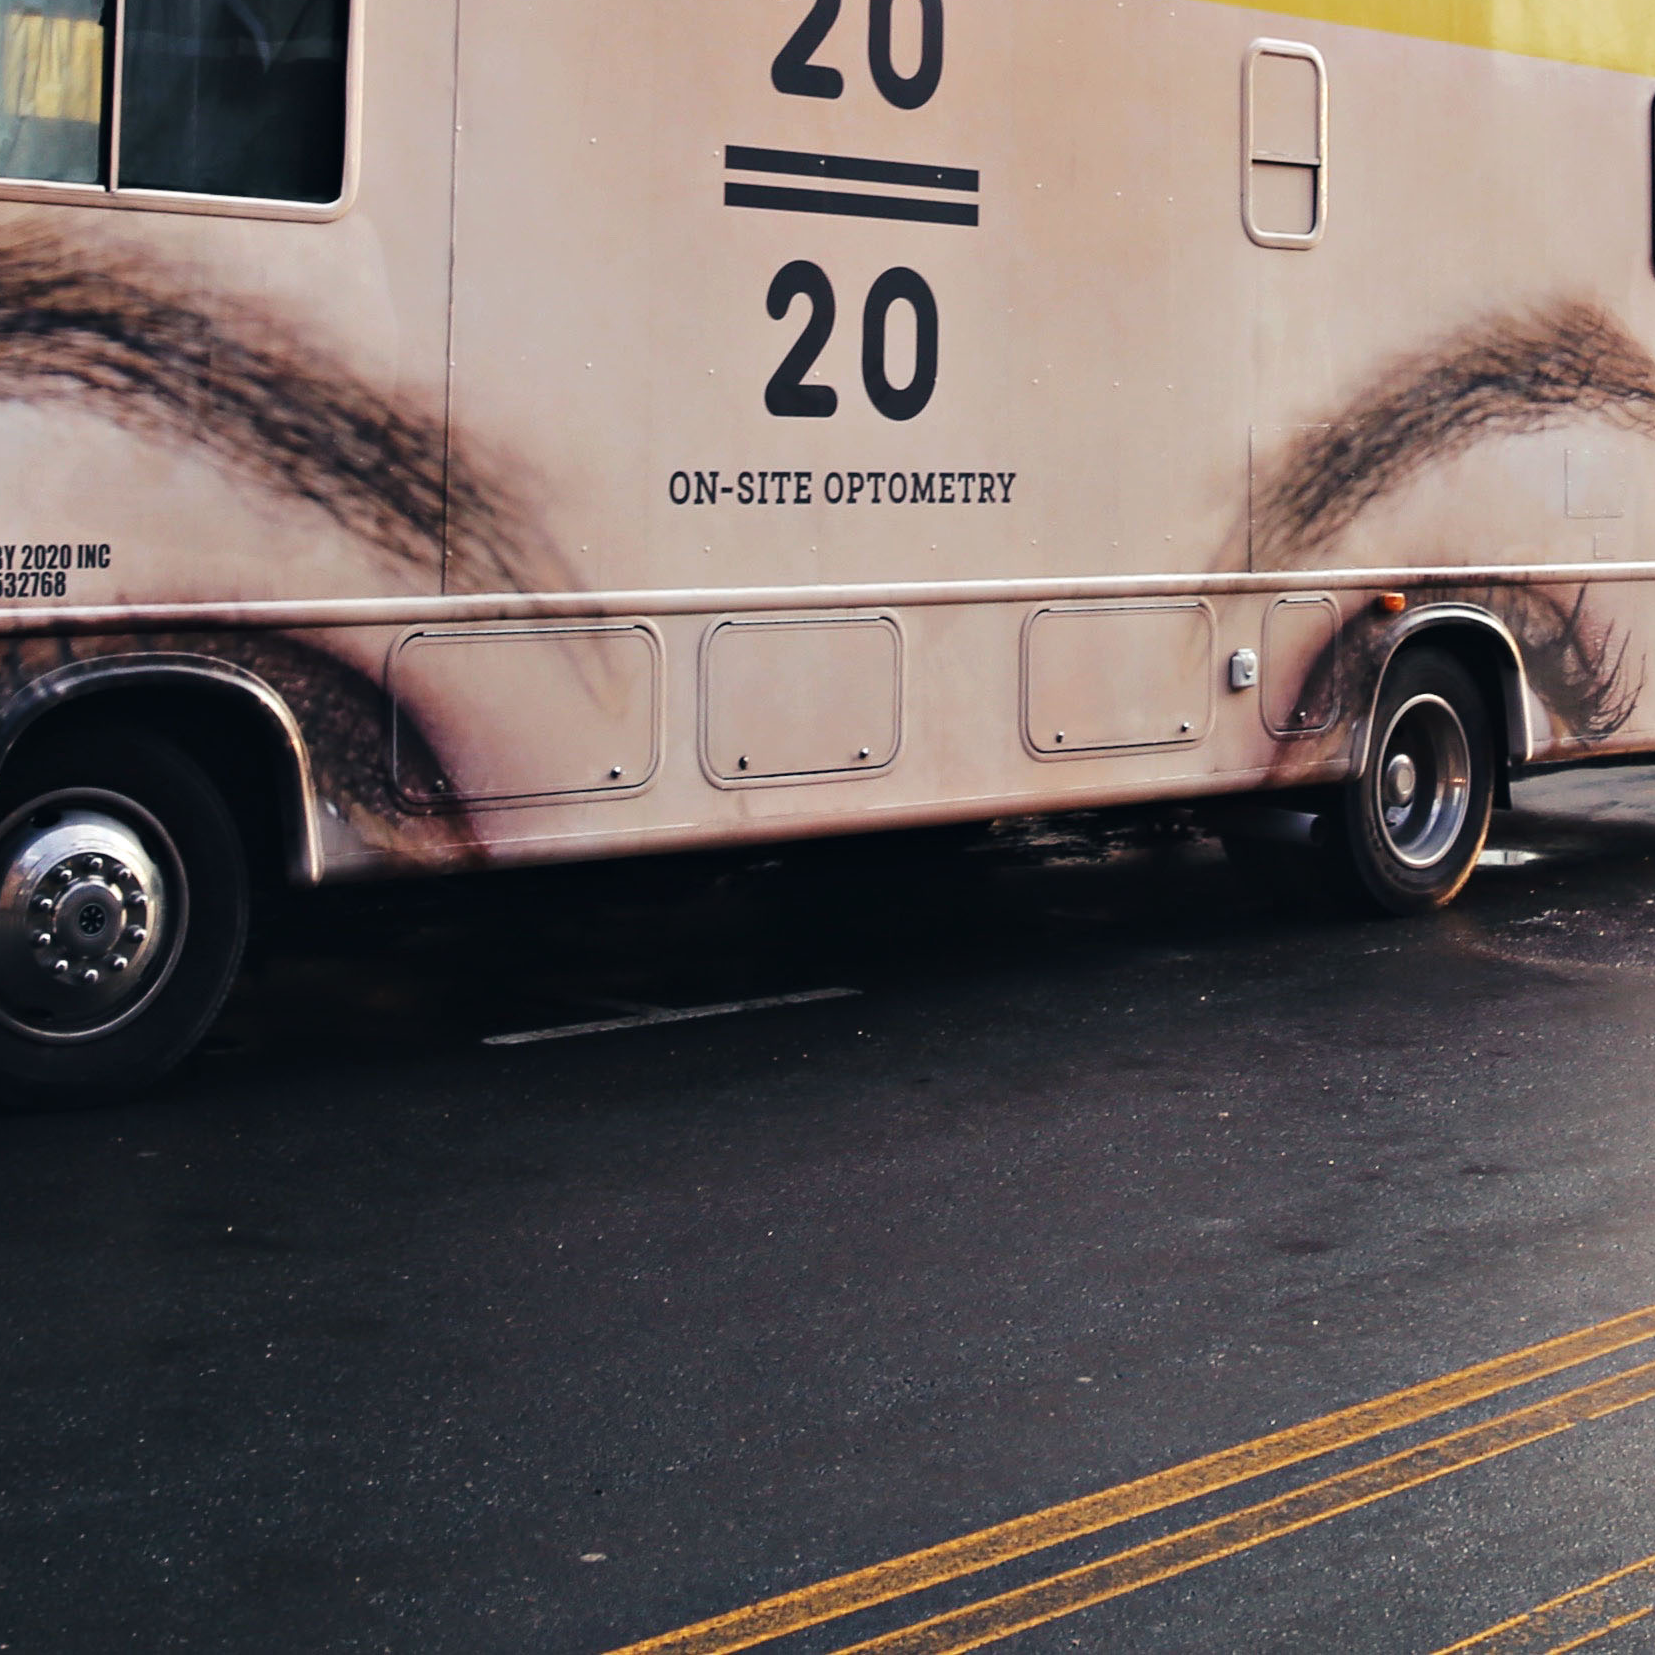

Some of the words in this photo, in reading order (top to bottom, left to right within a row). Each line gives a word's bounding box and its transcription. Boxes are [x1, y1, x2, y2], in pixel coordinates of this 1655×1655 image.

[764, 259, 939, 422] 20
[668, 471, 813, 505] ON-SITE
[824, 471, 1017, 505] OPTOMETRY
[21, 544, 72, 570] 2020
[77, 543, 112, 569] INC
